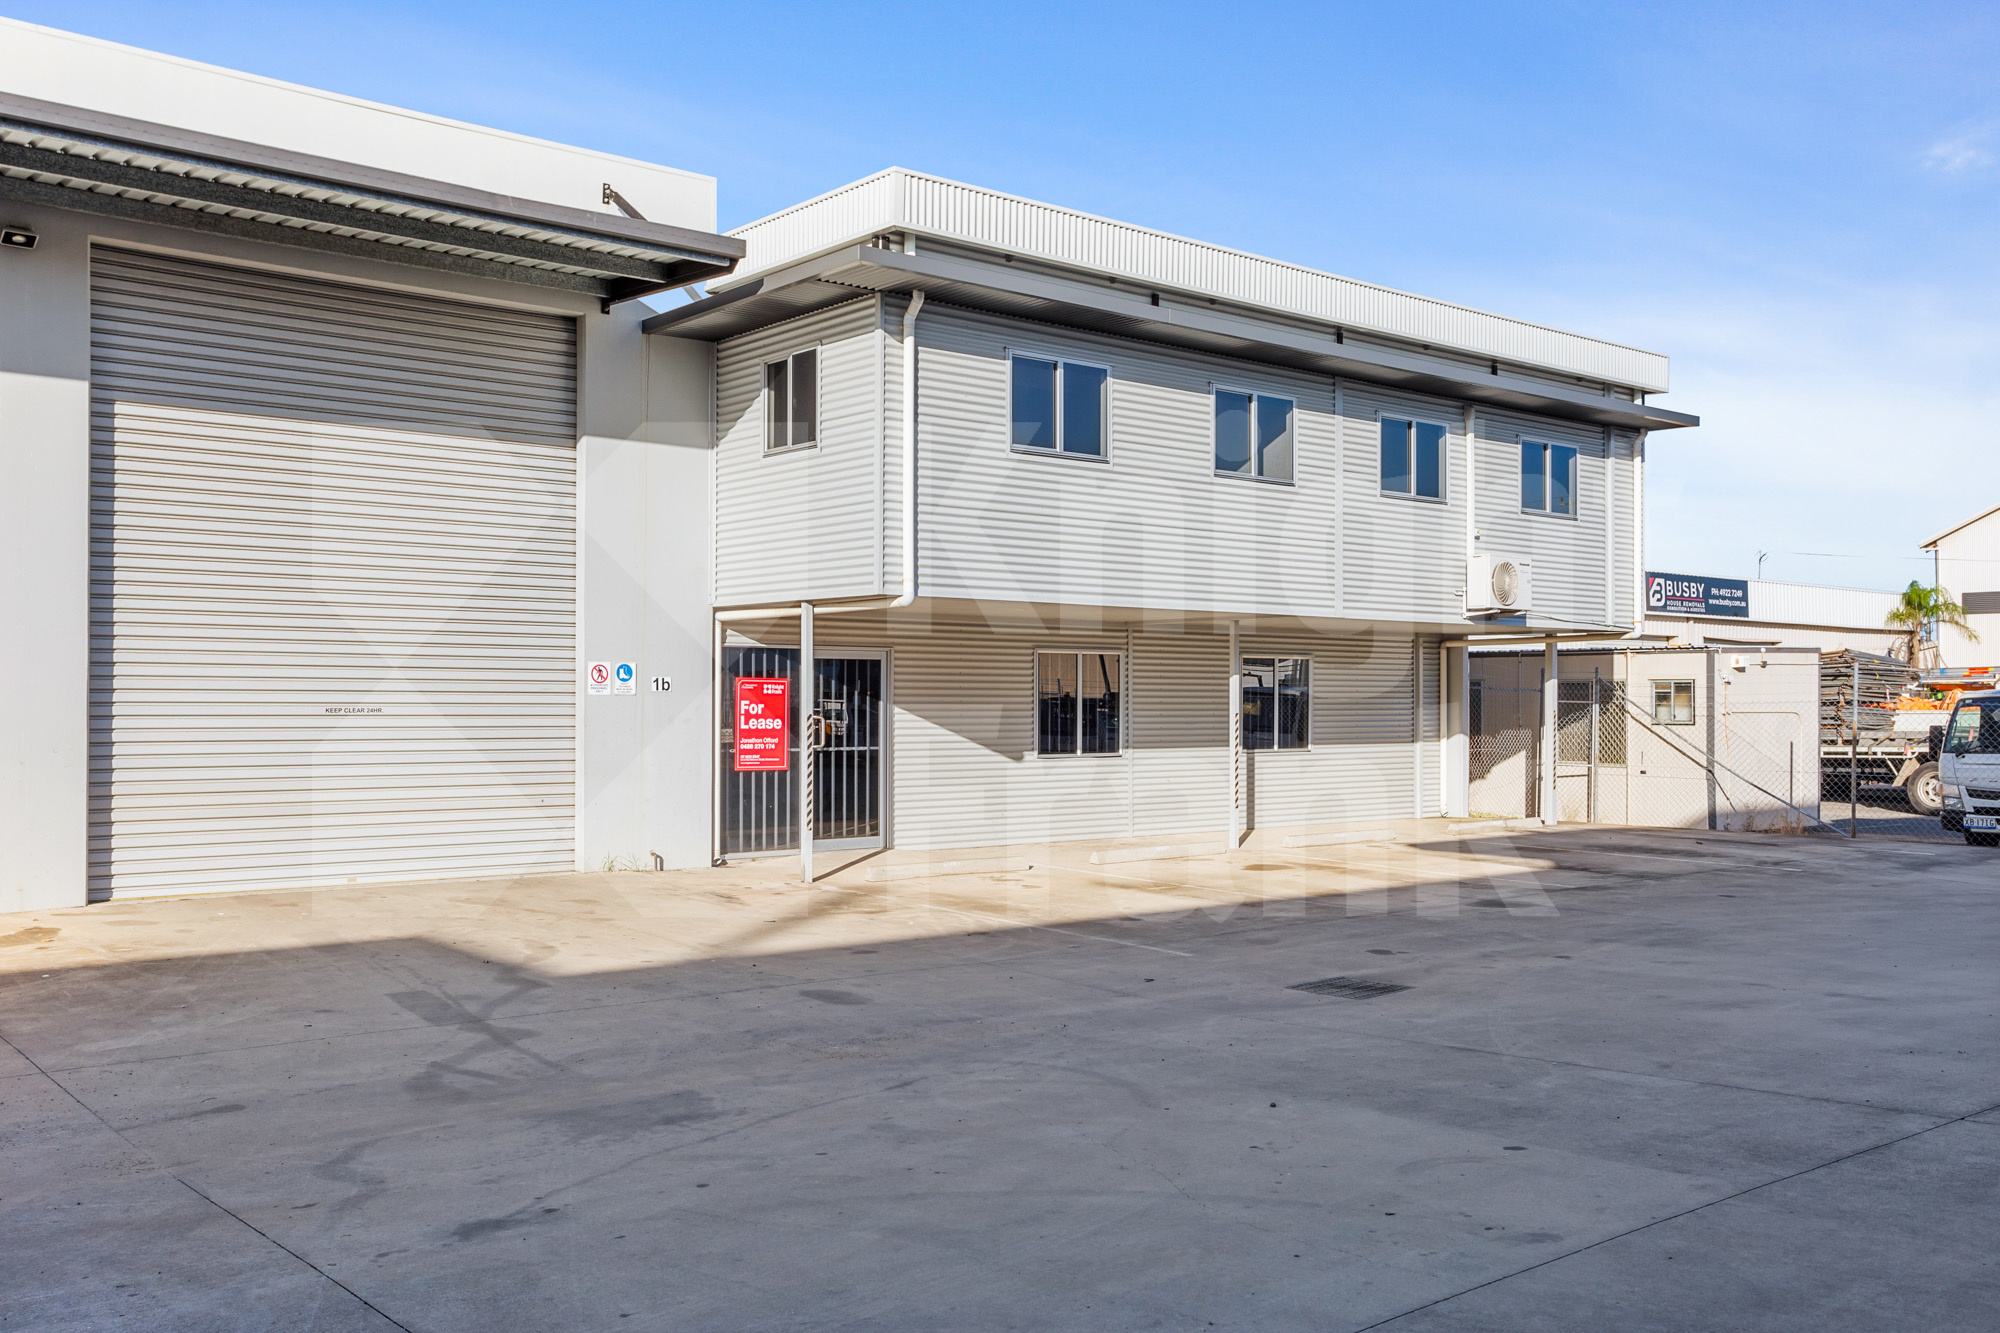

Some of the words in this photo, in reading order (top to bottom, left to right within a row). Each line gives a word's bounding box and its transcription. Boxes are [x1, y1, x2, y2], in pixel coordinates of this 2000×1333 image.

[1666, 580, 1705, 598] BUSBY
[1719, 588, 1731, 597] 4922
[1708, 598, 1747, 607] www.busby.com.au
[653, 677, 670, 690] 1b
[740, 700, 765, 715] For
[740, 715, 782, 729] Lease
